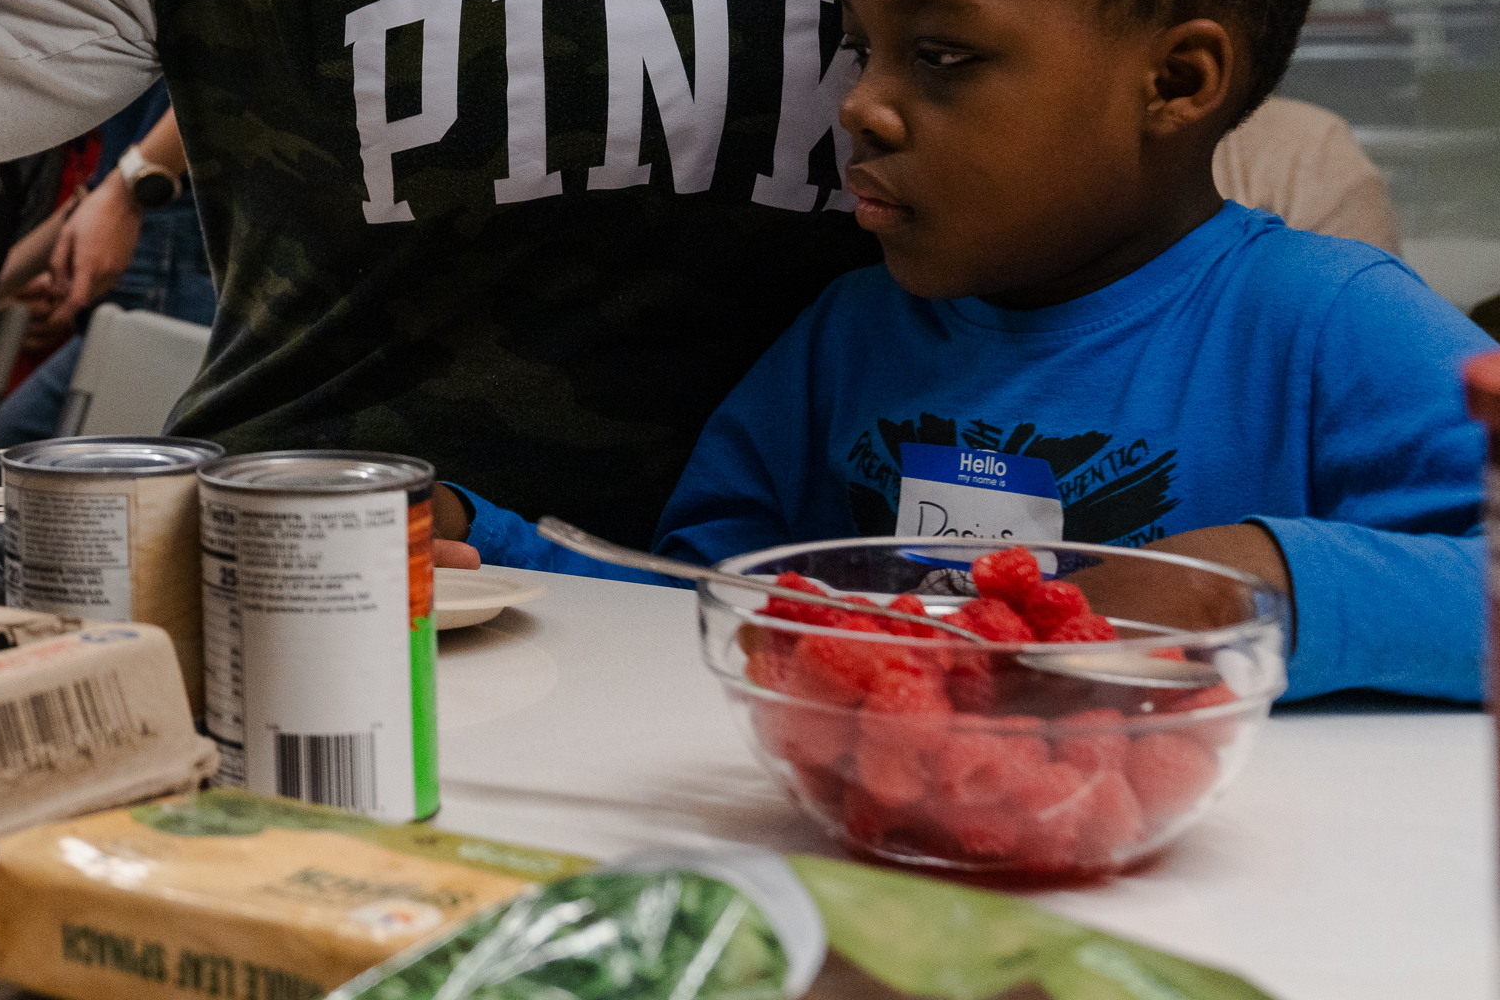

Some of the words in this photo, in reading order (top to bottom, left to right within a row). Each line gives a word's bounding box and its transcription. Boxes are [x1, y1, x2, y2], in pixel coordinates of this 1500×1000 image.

[960, 453, 1007, 477] Hello
[958, 474, 970, 484] my
[972, 476, 997, 487] name
[999, 479, 1006, 488] is
[61, 921, 169, 985] SPINACH
